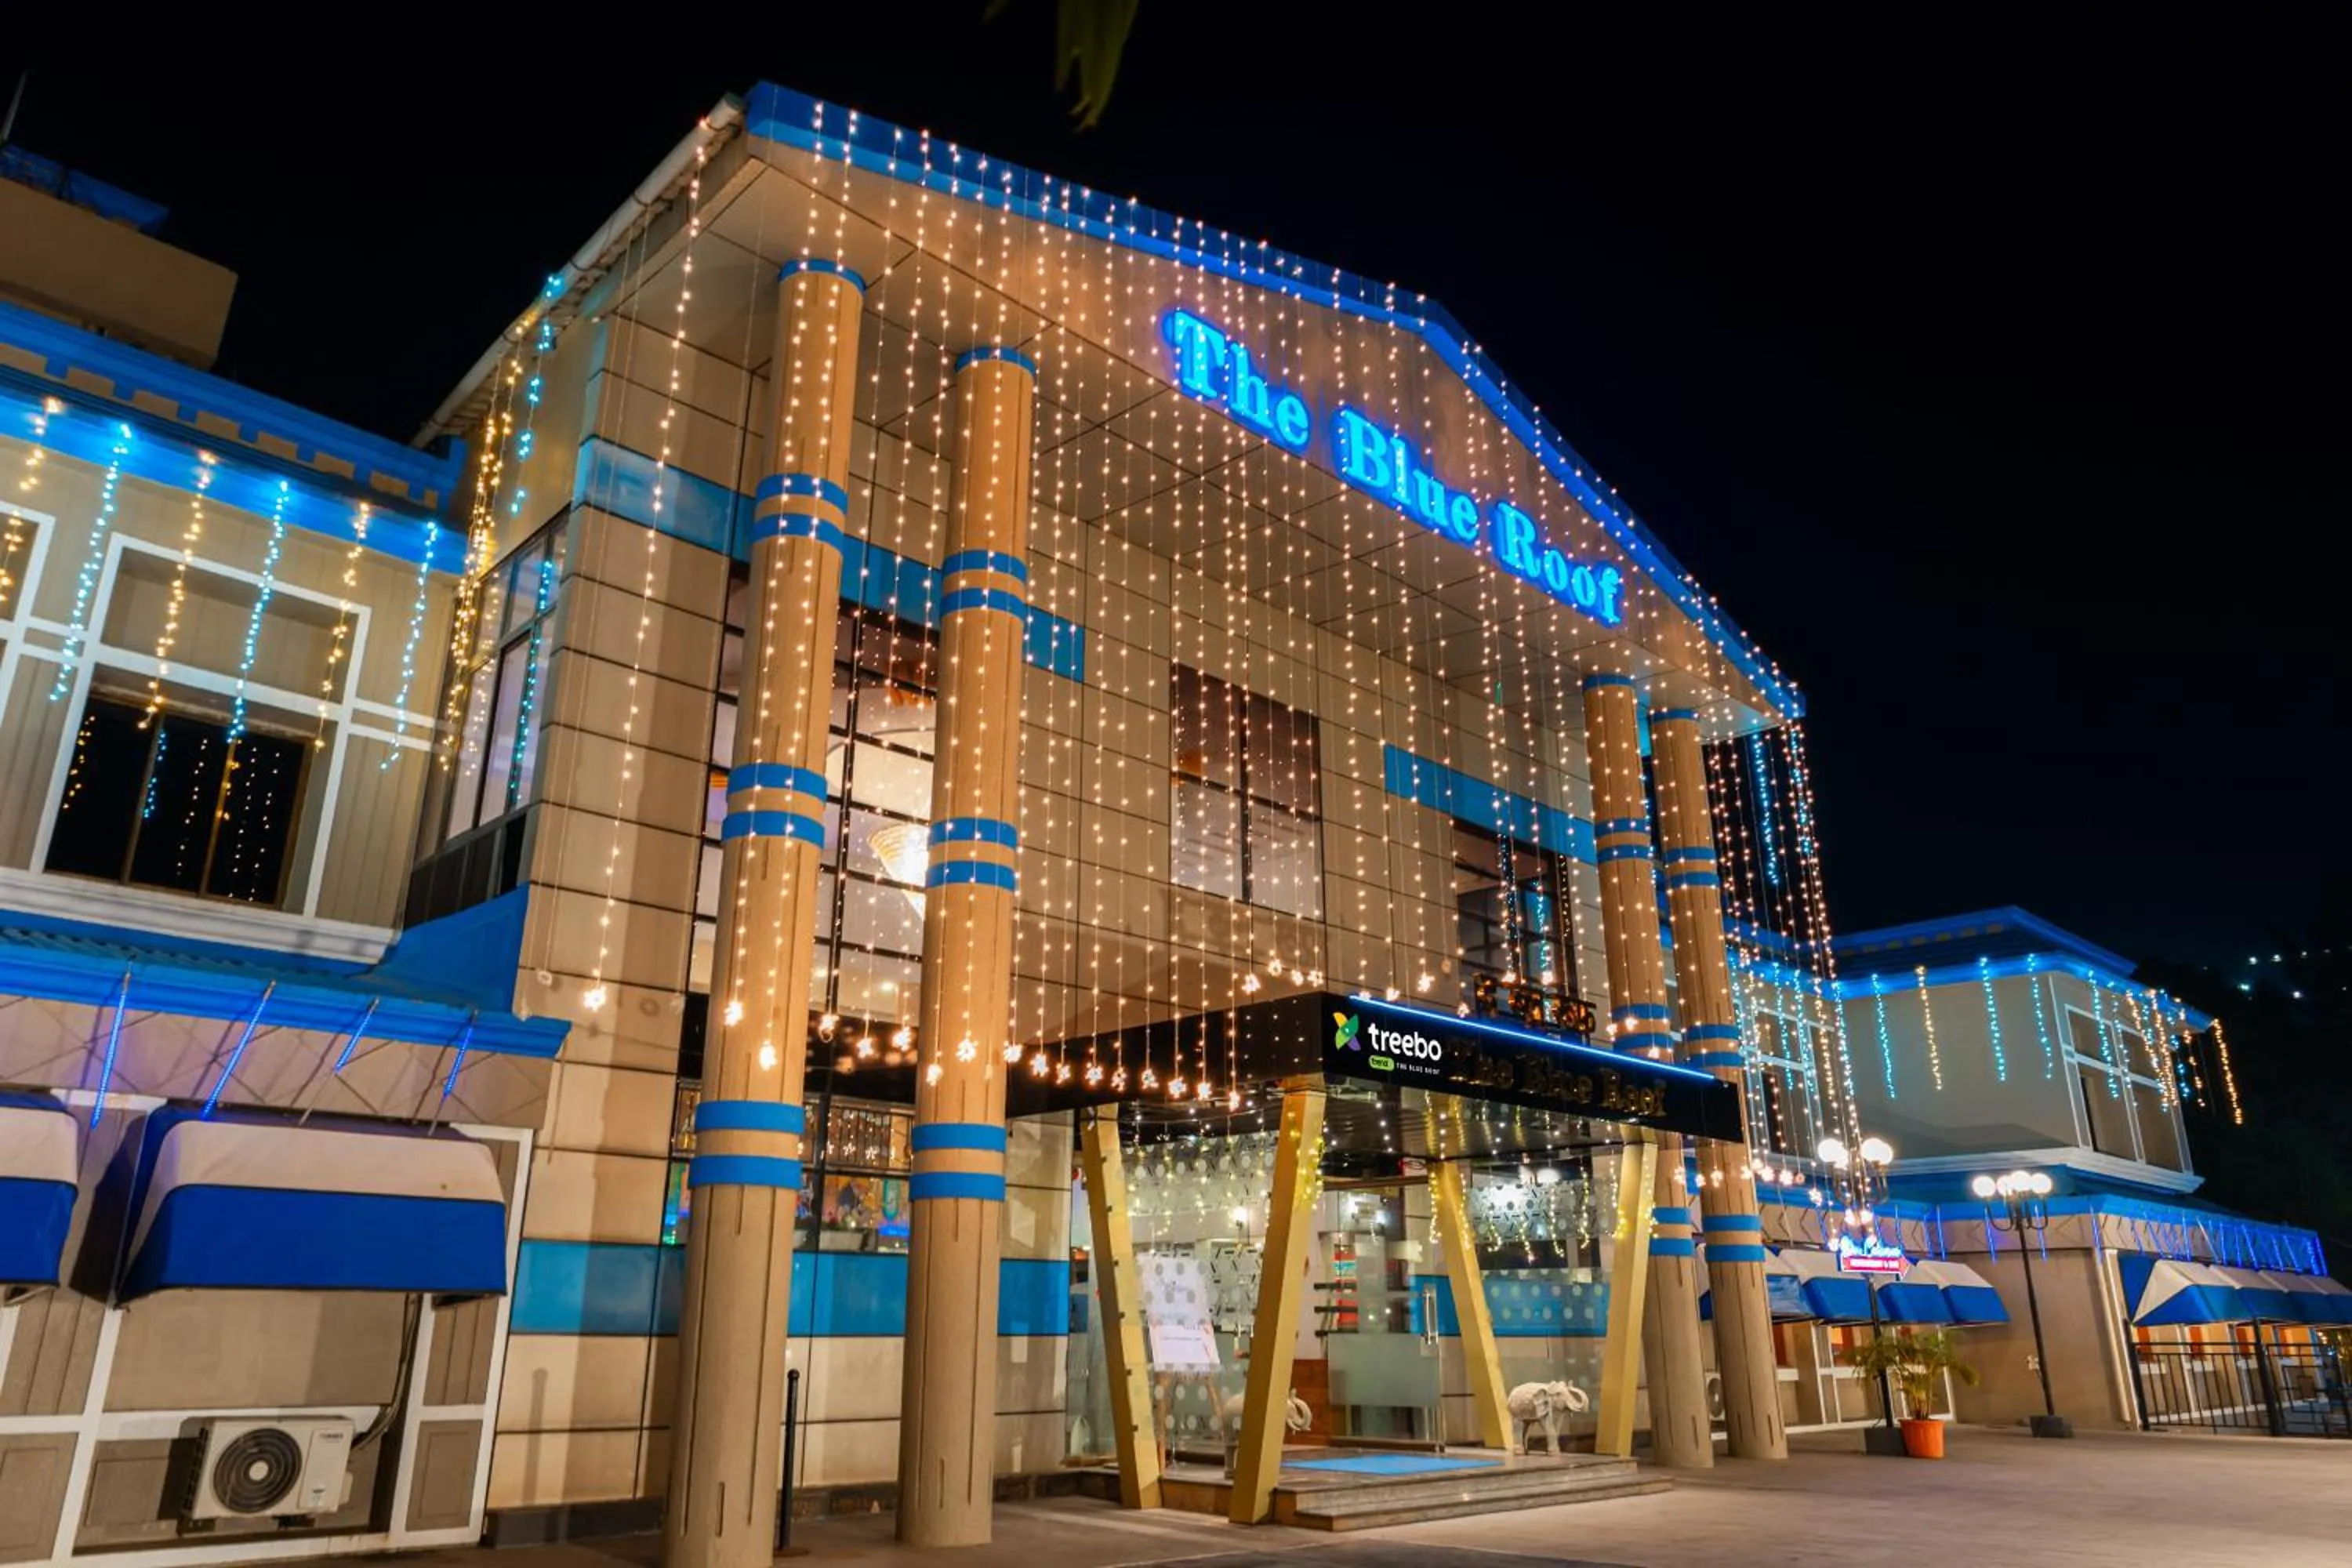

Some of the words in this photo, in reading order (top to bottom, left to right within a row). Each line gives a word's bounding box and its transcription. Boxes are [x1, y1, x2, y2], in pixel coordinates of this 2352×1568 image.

[1163, 310, 1311, 449] The
[1338, 407, 1480, 542] Blue
[1494, 501, 1624, 626] Roof
[1367, 1022, 1442, 1062] treebo
